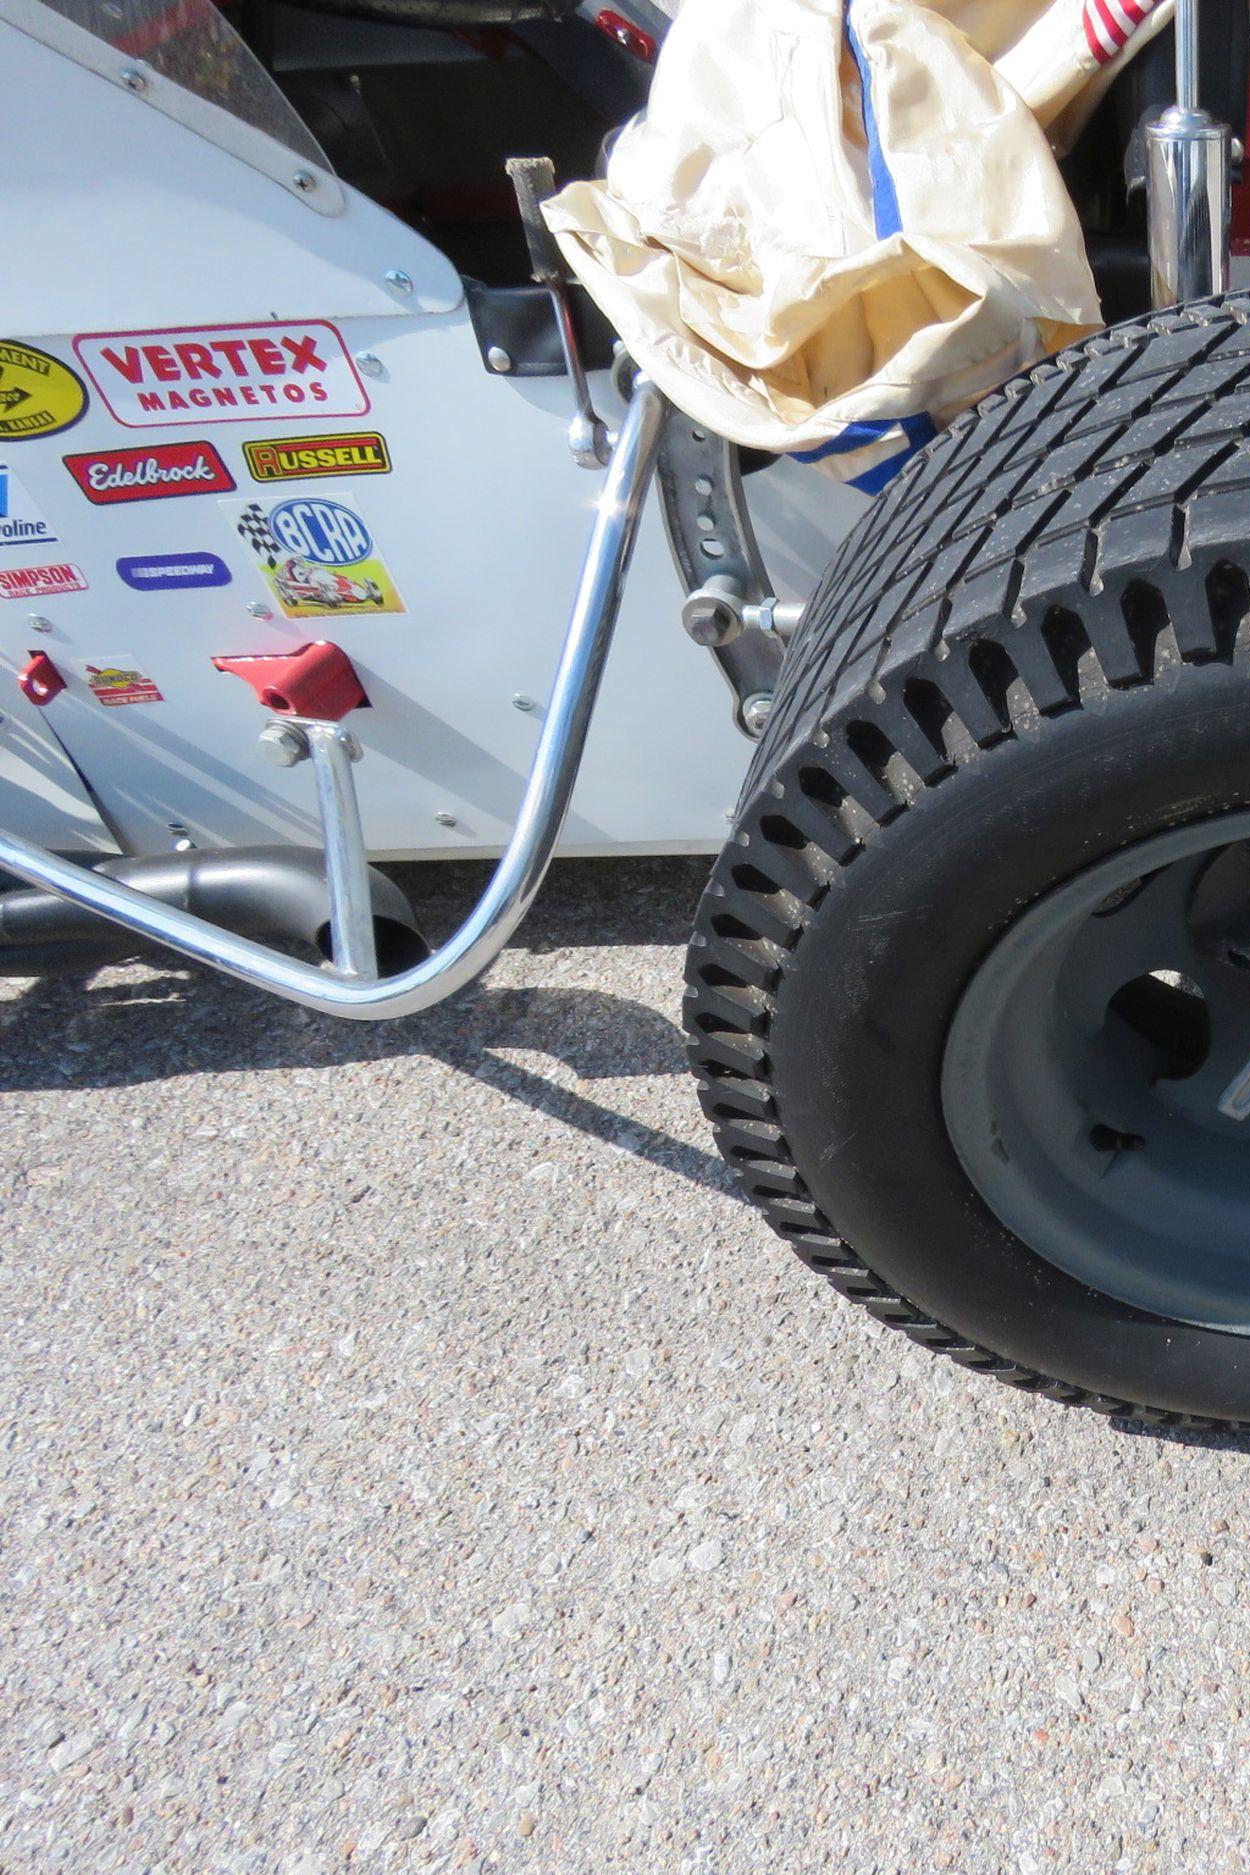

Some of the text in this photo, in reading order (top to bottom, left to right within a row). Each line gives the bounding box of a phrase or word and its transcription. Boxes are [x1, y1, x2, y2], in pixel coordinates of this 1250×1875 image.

[100, 335, 328, 384] VERTEX
[136, 381, 329, 412] MAGNETOS
[87, 455, 216, 491] Edelbrock
[252, 445, 381, 478] RUSSELL
[274, 501, 368, 563] BCRA
[0, 564, 77, 590] SIMPSON
[147, 563, 215, 578] SPEEDWAY
